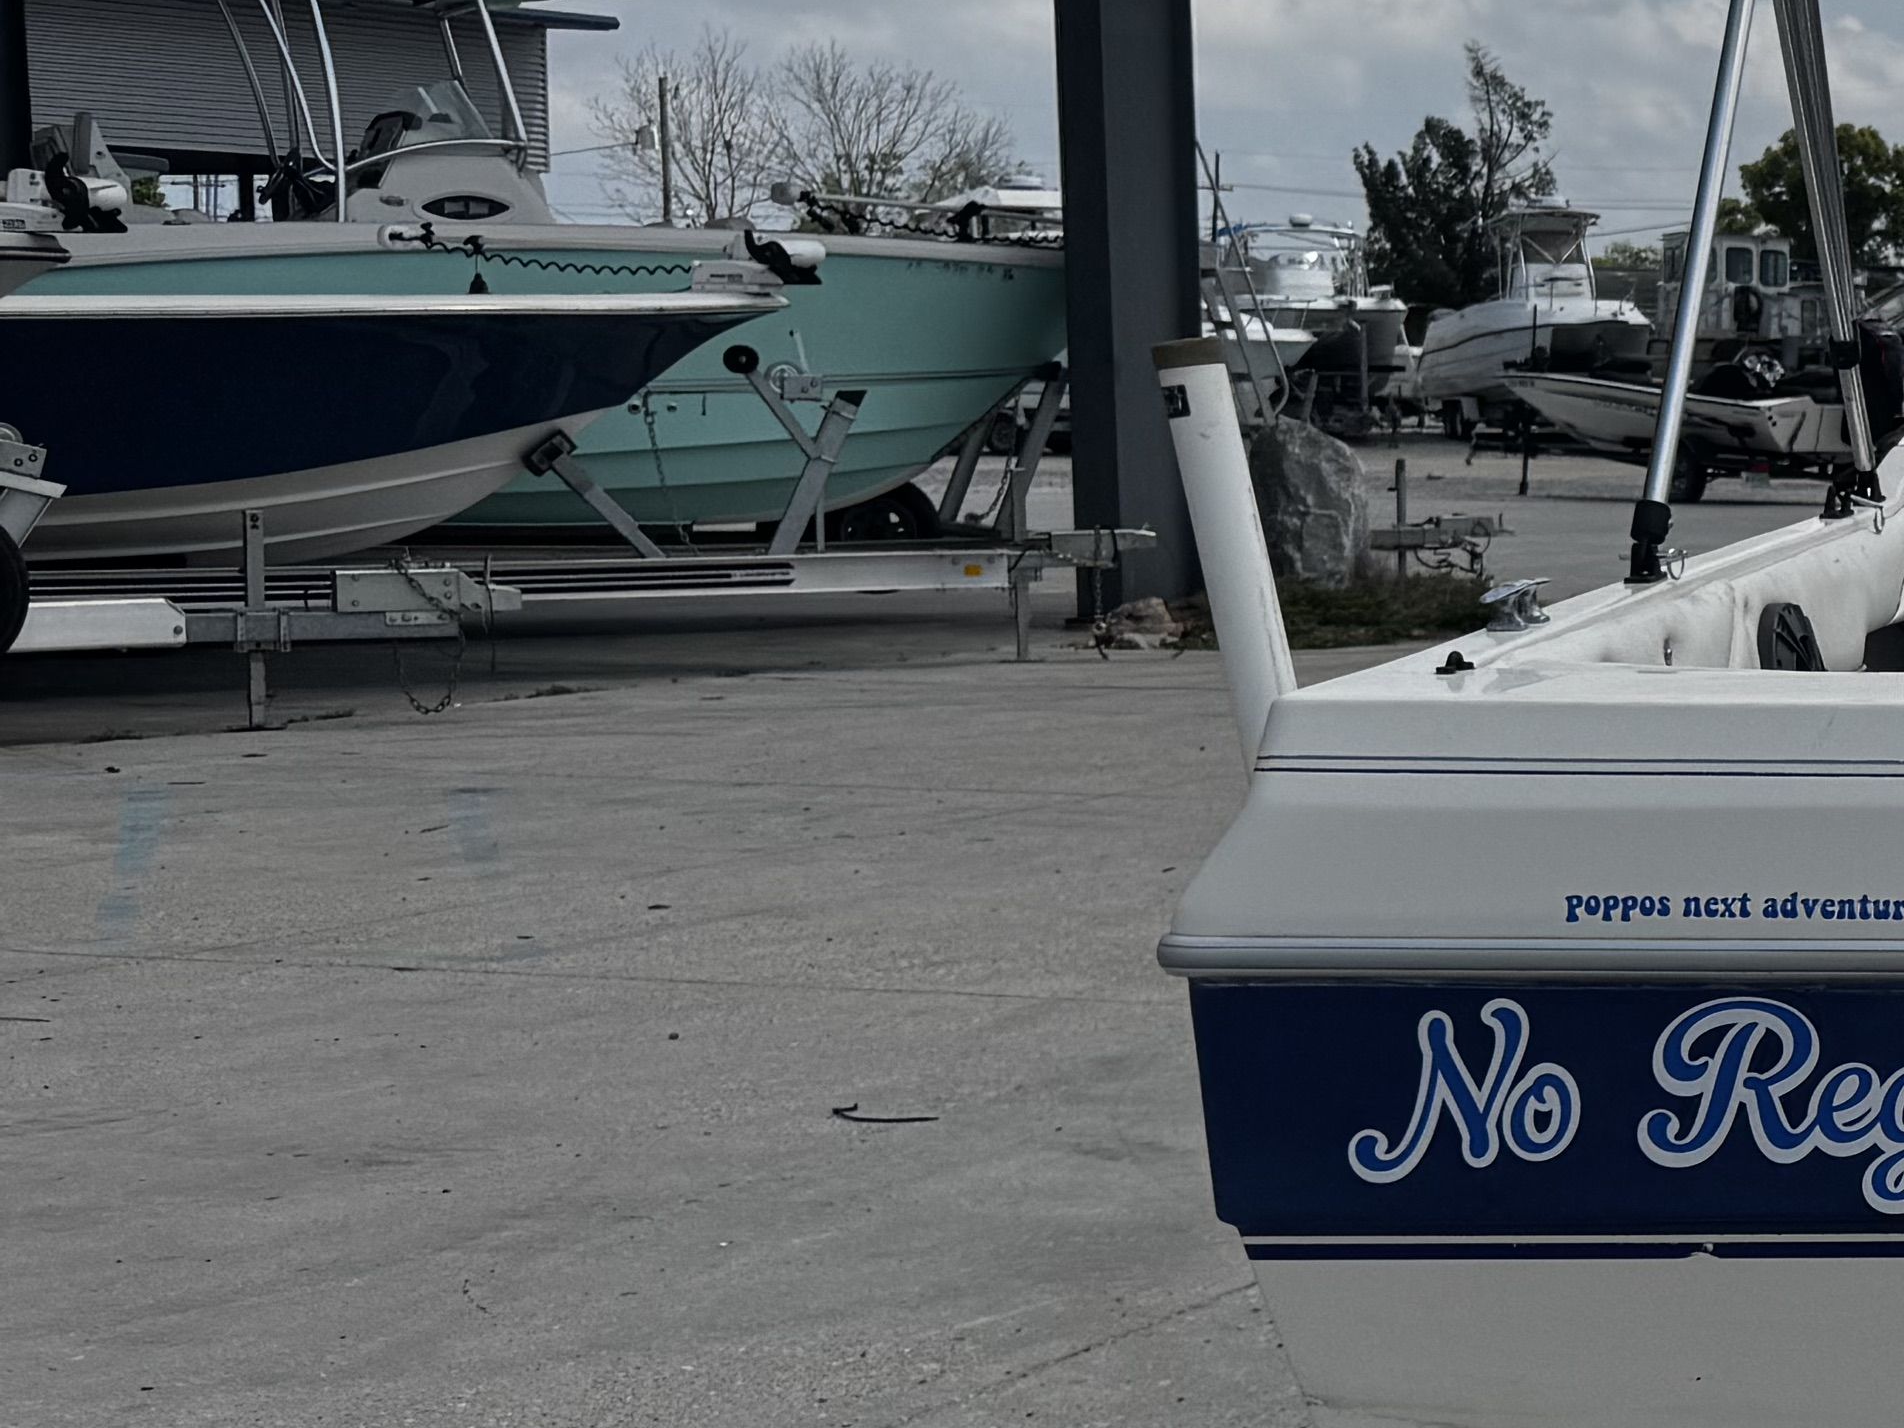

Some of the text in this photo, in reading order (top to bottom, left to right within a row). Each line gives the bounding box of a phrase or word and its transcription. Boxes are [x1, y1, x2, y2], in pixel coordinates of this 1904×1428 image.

[1565, 894, 1671, 922] poppos
[1683, 892, 1752, 918] next
[1348, 998, 1581, 1183] No
